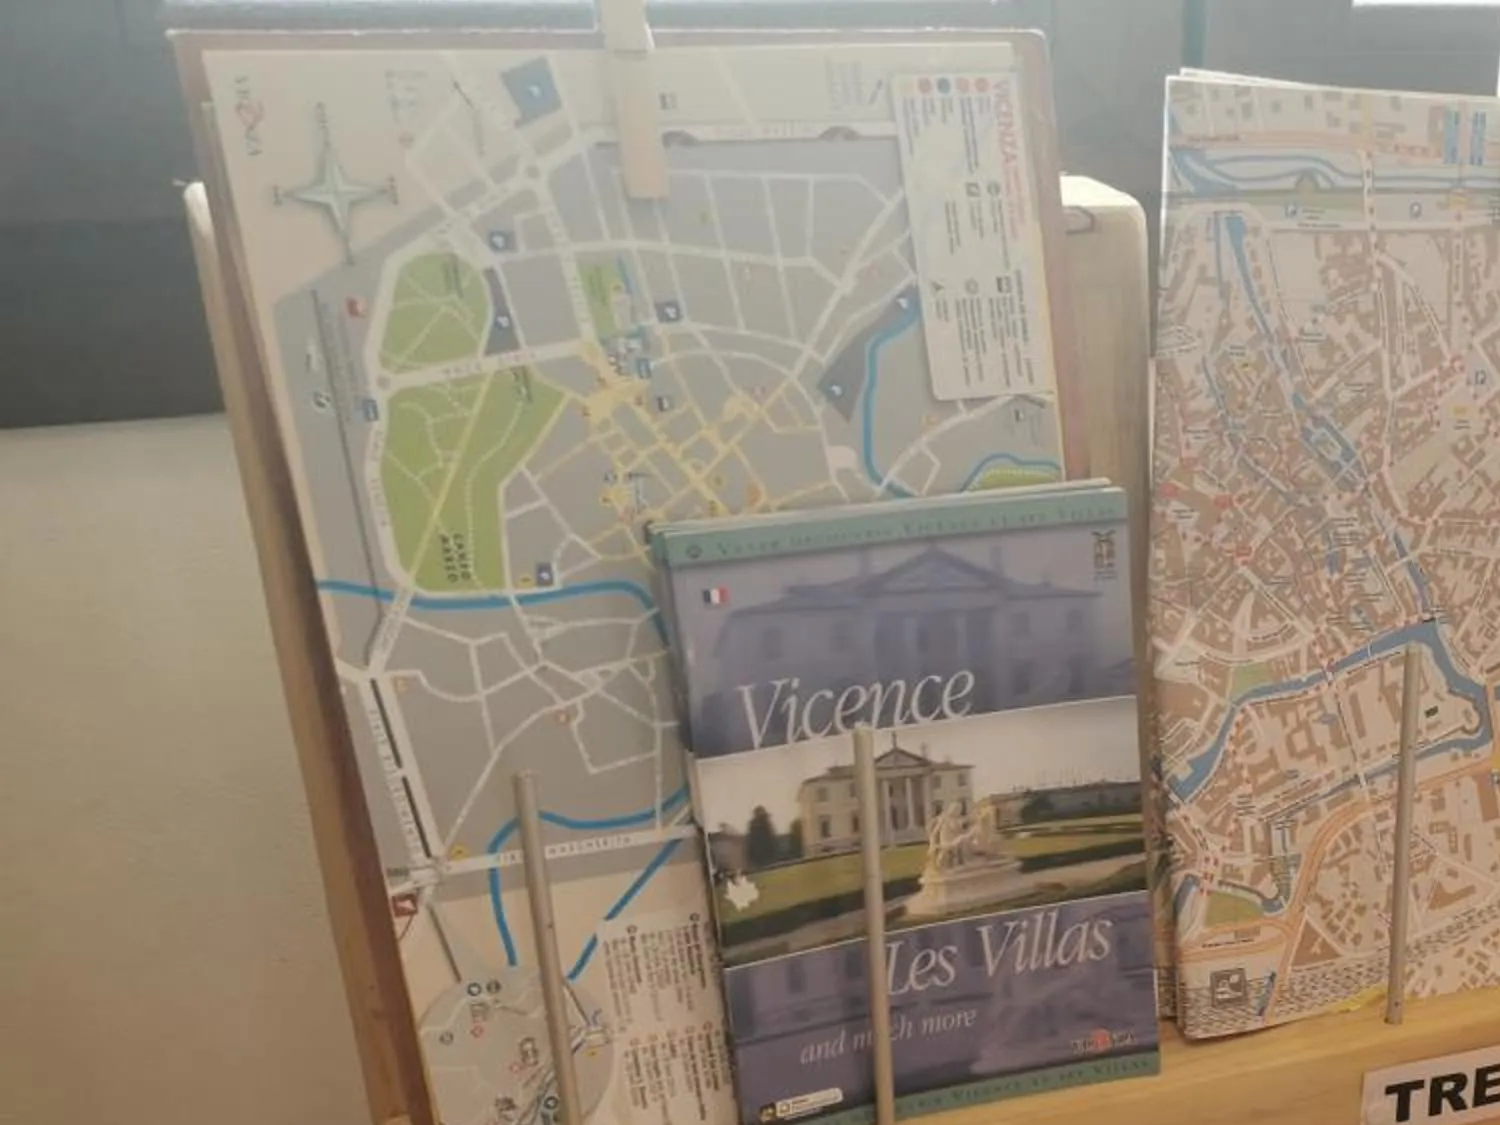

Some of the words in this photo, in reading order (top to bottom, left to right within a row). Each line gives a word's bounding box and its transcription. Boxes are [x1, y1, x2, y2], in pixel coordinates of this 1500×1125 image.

[737, 669, 976, 750] Vicence
[886, 941, 957, 996] Les
[978, 908, 1113, 977] Villas
[801, 1030, 845, 1065] and
[853, 1018, 913, 1054] mch
[921, 1008, 978, 1033] more
